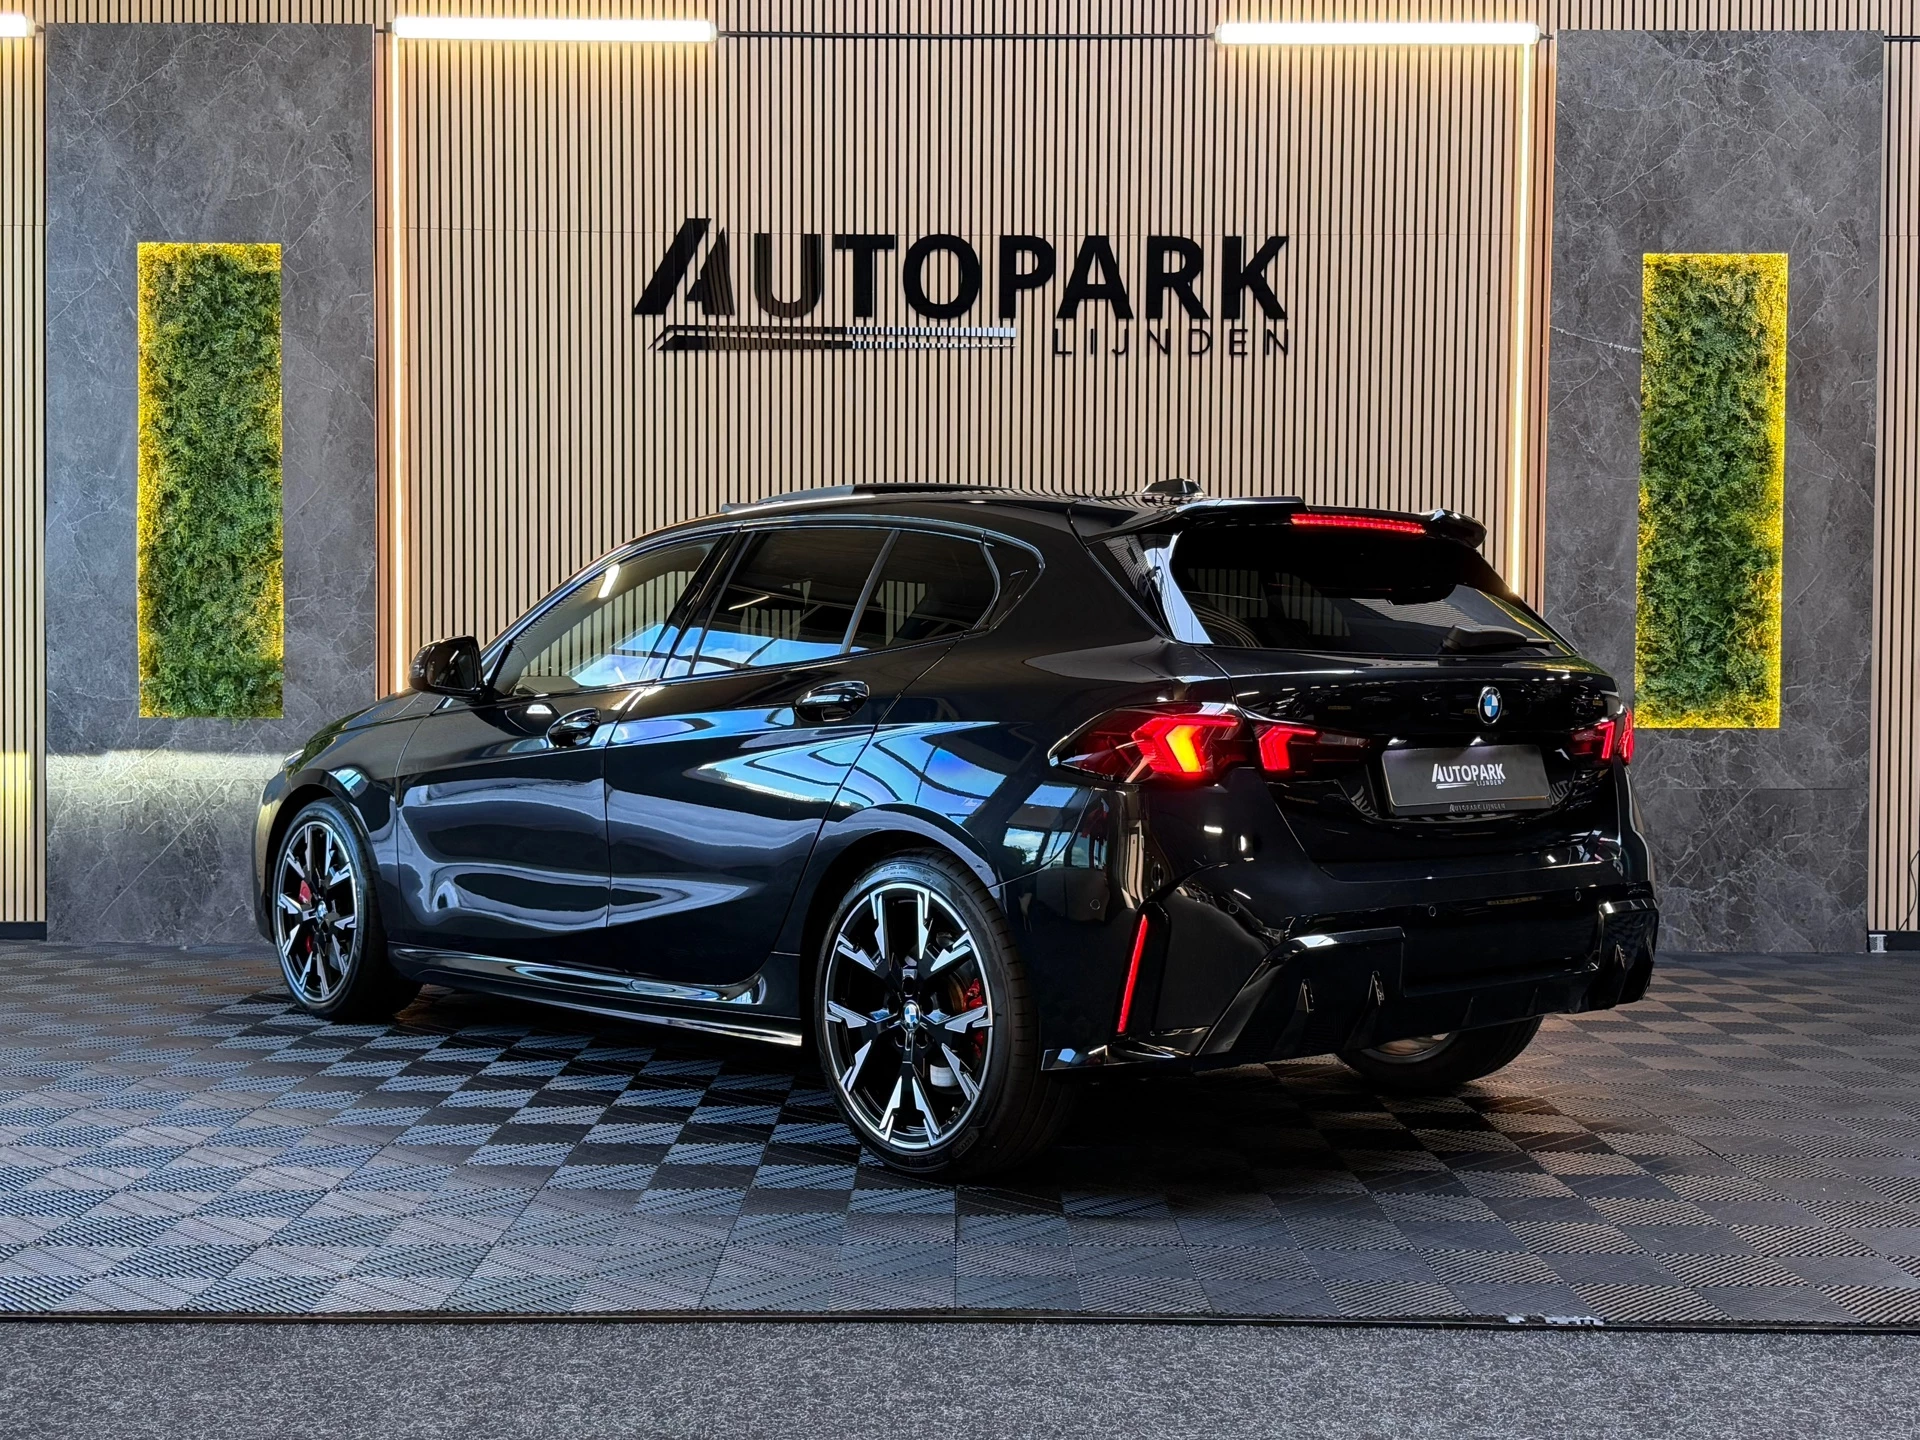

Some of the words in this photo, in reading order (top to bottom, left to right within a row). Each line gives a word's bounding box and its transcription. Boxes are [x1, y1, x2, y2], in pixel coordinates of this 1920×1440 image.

[632, 217, 1290, 321] AUTOPARK
[1053, 327, 1290, 357] LIJNDEN
[1431, 763, 1506, 783] AUTOPARK
